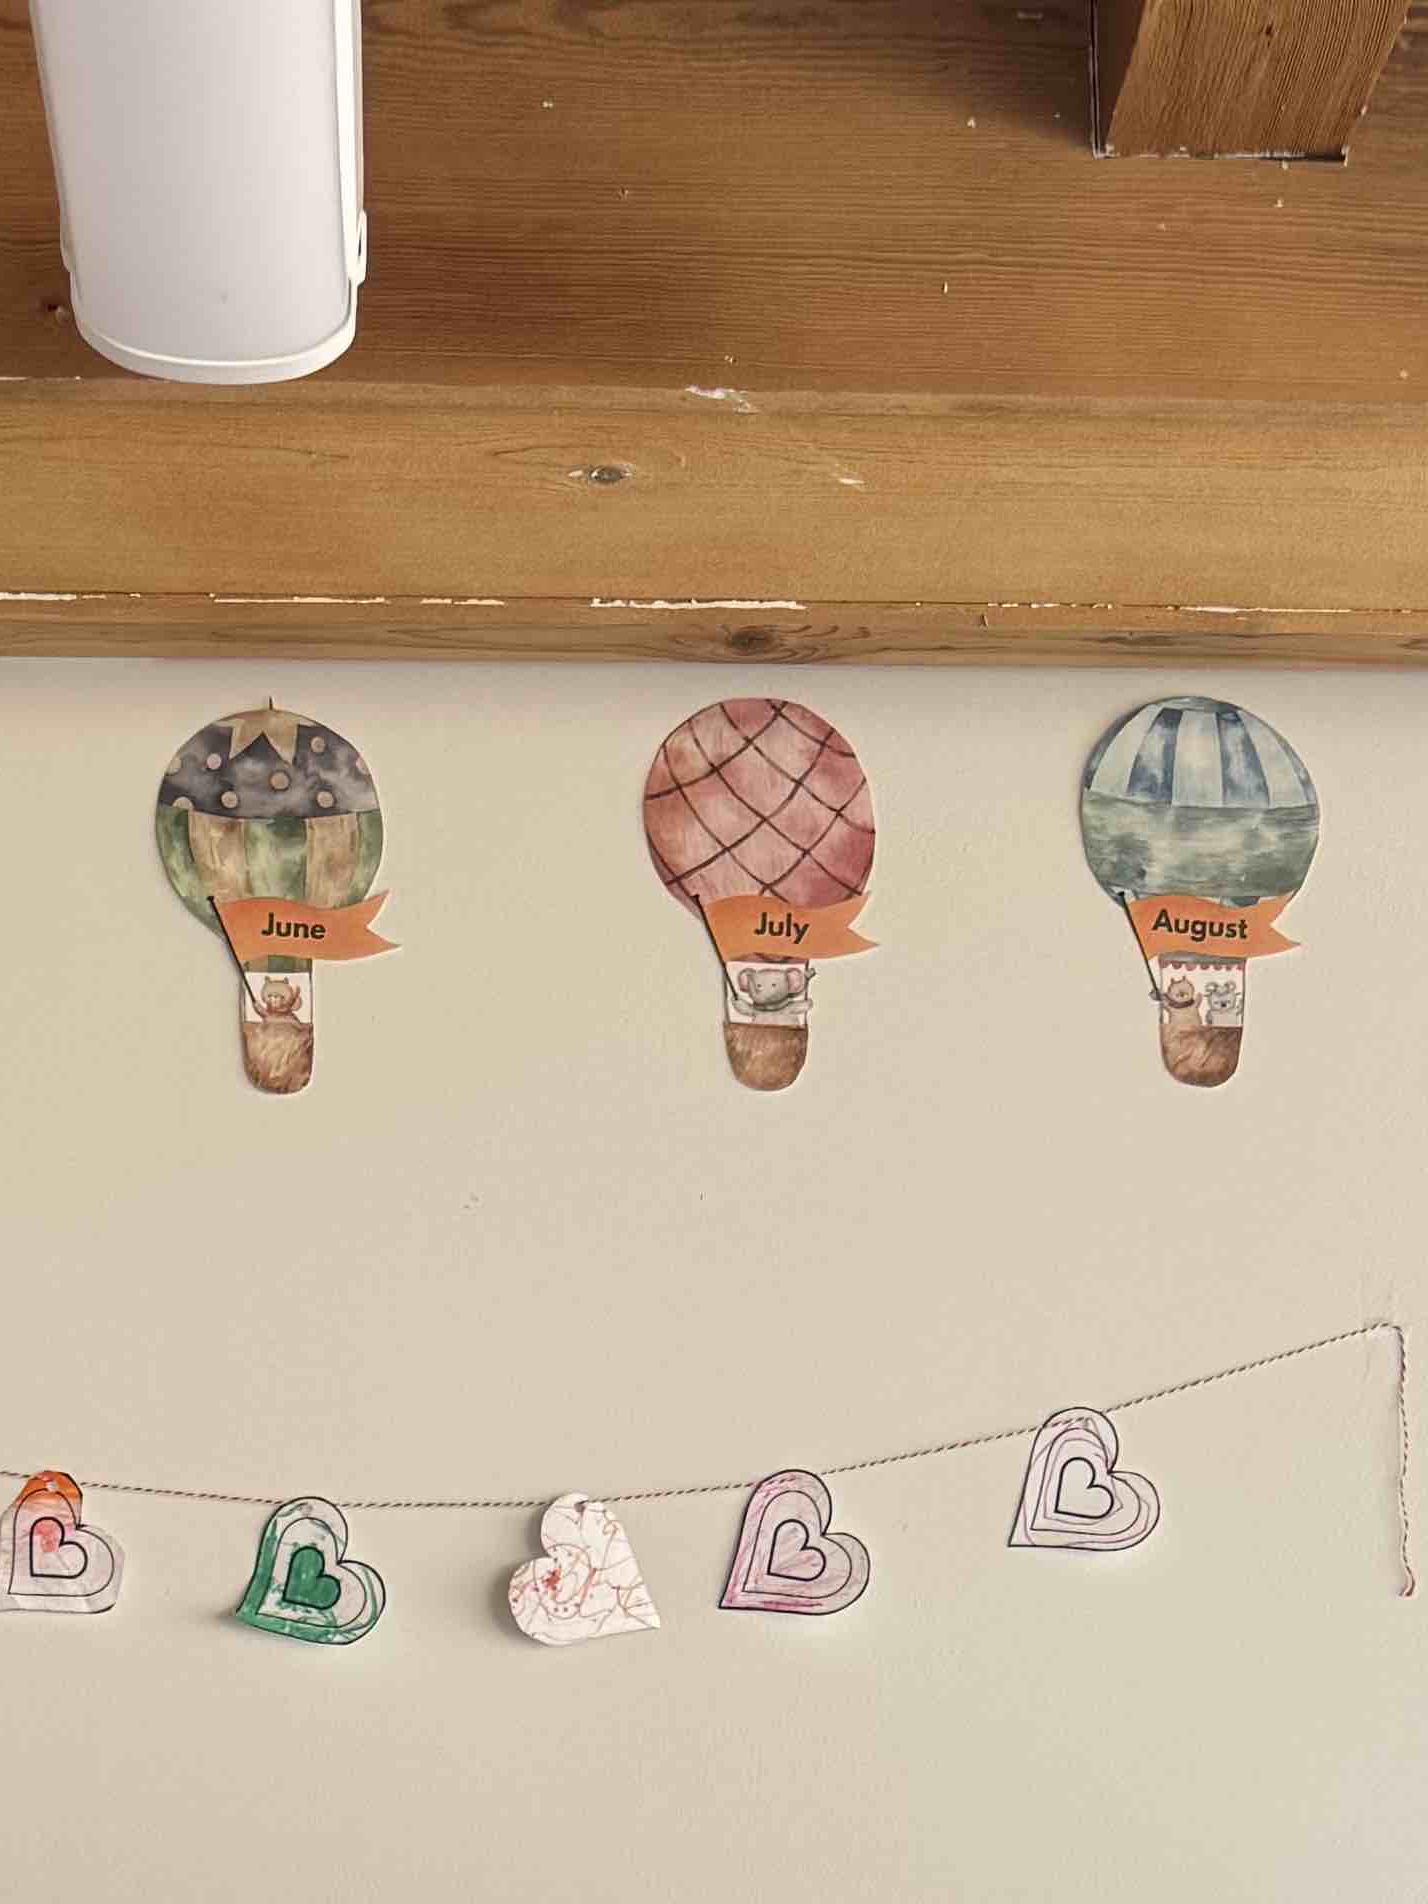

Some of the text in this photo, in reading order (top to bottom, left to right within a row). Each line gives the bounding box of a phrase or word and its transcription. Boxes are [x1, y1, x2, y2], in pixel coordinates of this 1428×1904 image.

[261, 911, 327, 940] June
[753, 911, 810, 945] July
[1151, 908, 1248, 942] August
